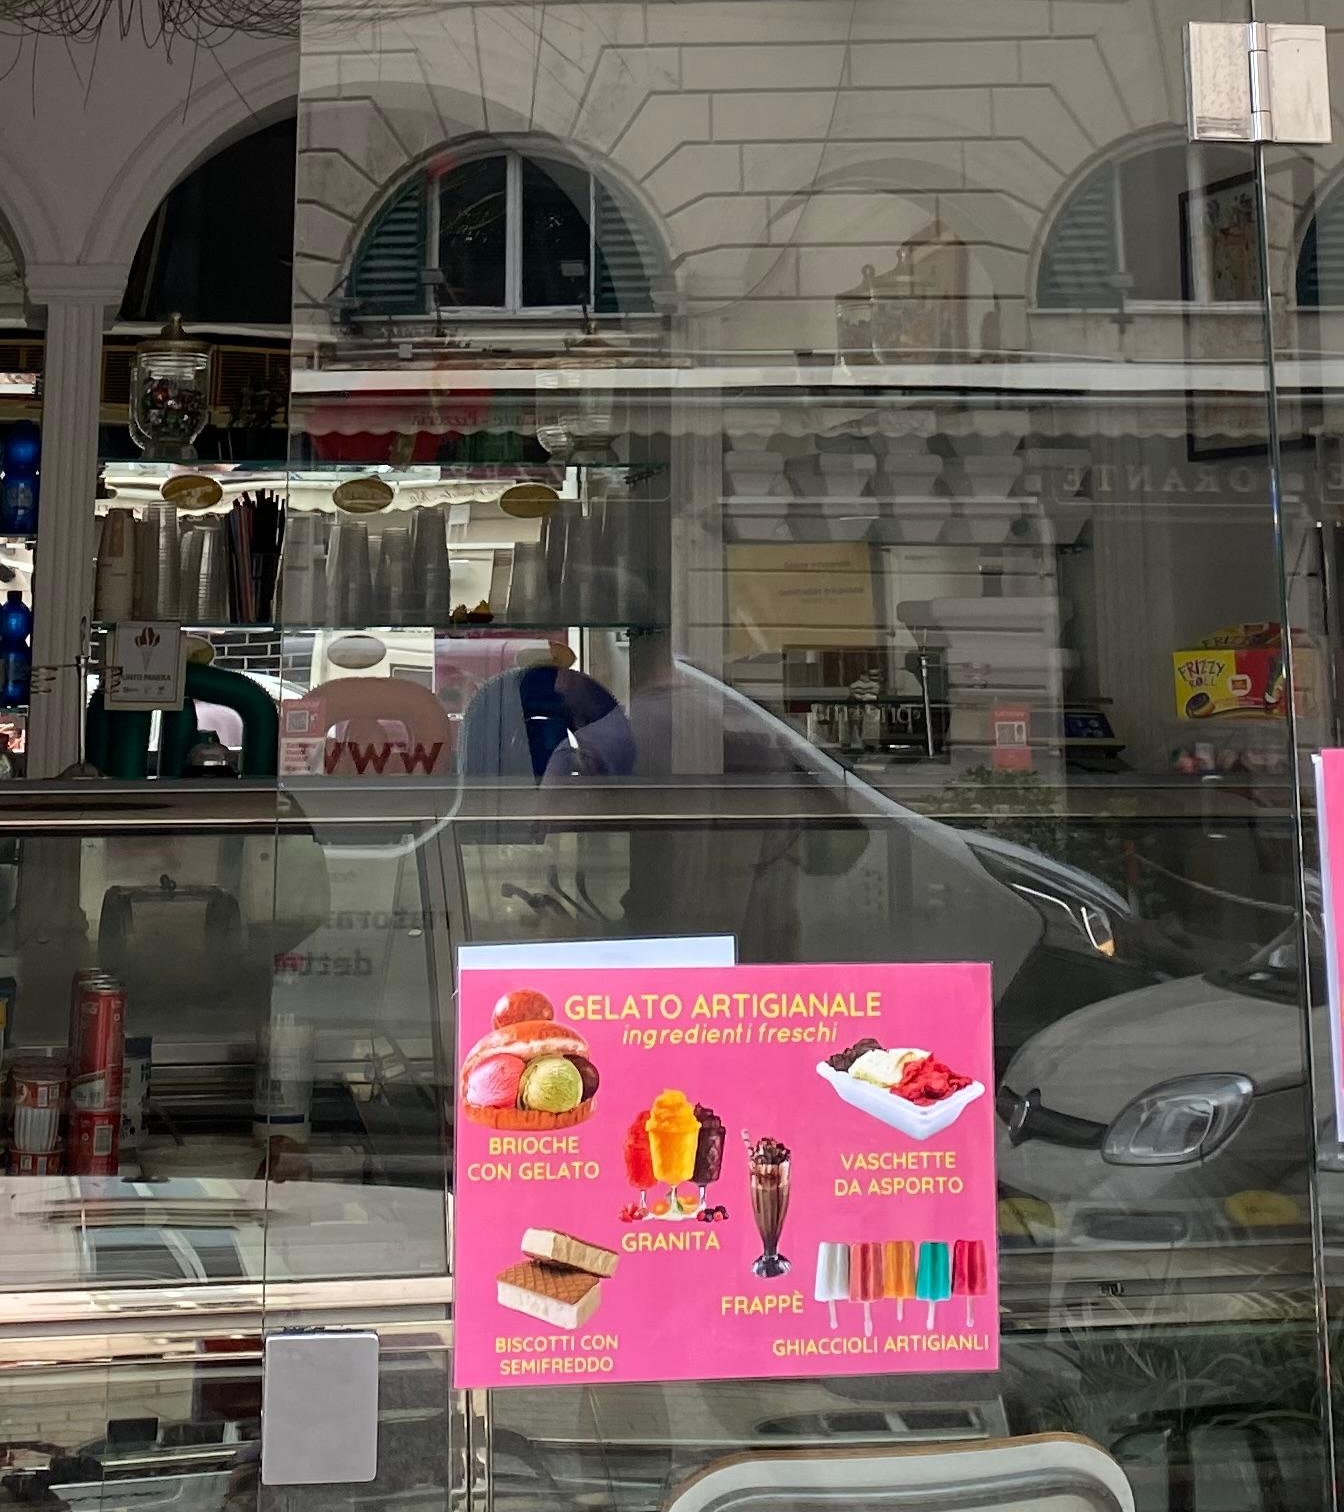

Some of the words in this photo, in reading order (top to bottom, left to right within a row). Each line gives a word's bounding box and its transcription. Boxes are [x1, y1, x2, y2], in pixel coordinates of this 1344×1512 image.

[1178, 659, 1226, 681] FRIZZY
[564, 994, 681, 1021] GELATO
[692, 991, 882, 1019] ARTIGIANALE
[624, 1022, 753, 1049] ingredienti
[758, 1021, 838, 1044] freschi
[488, 1136, 579, 1155] BRIOCHE
[468, 1162, 512, 1180] CON
[520, 1161, 599, 1180] GELATO
[840, 1151, 956, 1170] VASCHETTE
[834, 1180, 863, 1196] DA
[868, 1176, 964, 1194] ASPORTO
[622, 1231, 719, 1250] GRANITA
[721, 1290, 804, 1314] FRAPPÈ
[494, 1335, 575, 1354] BISCOTTI
[581, 1333, 620, 1349] CON
[772, 1336, 878, 1356] GHIACCIOLI
[883, 1334, 990, 1353] ARTIGIANLI
[499, 1357, 614, 1375] SEMIFREDDO
